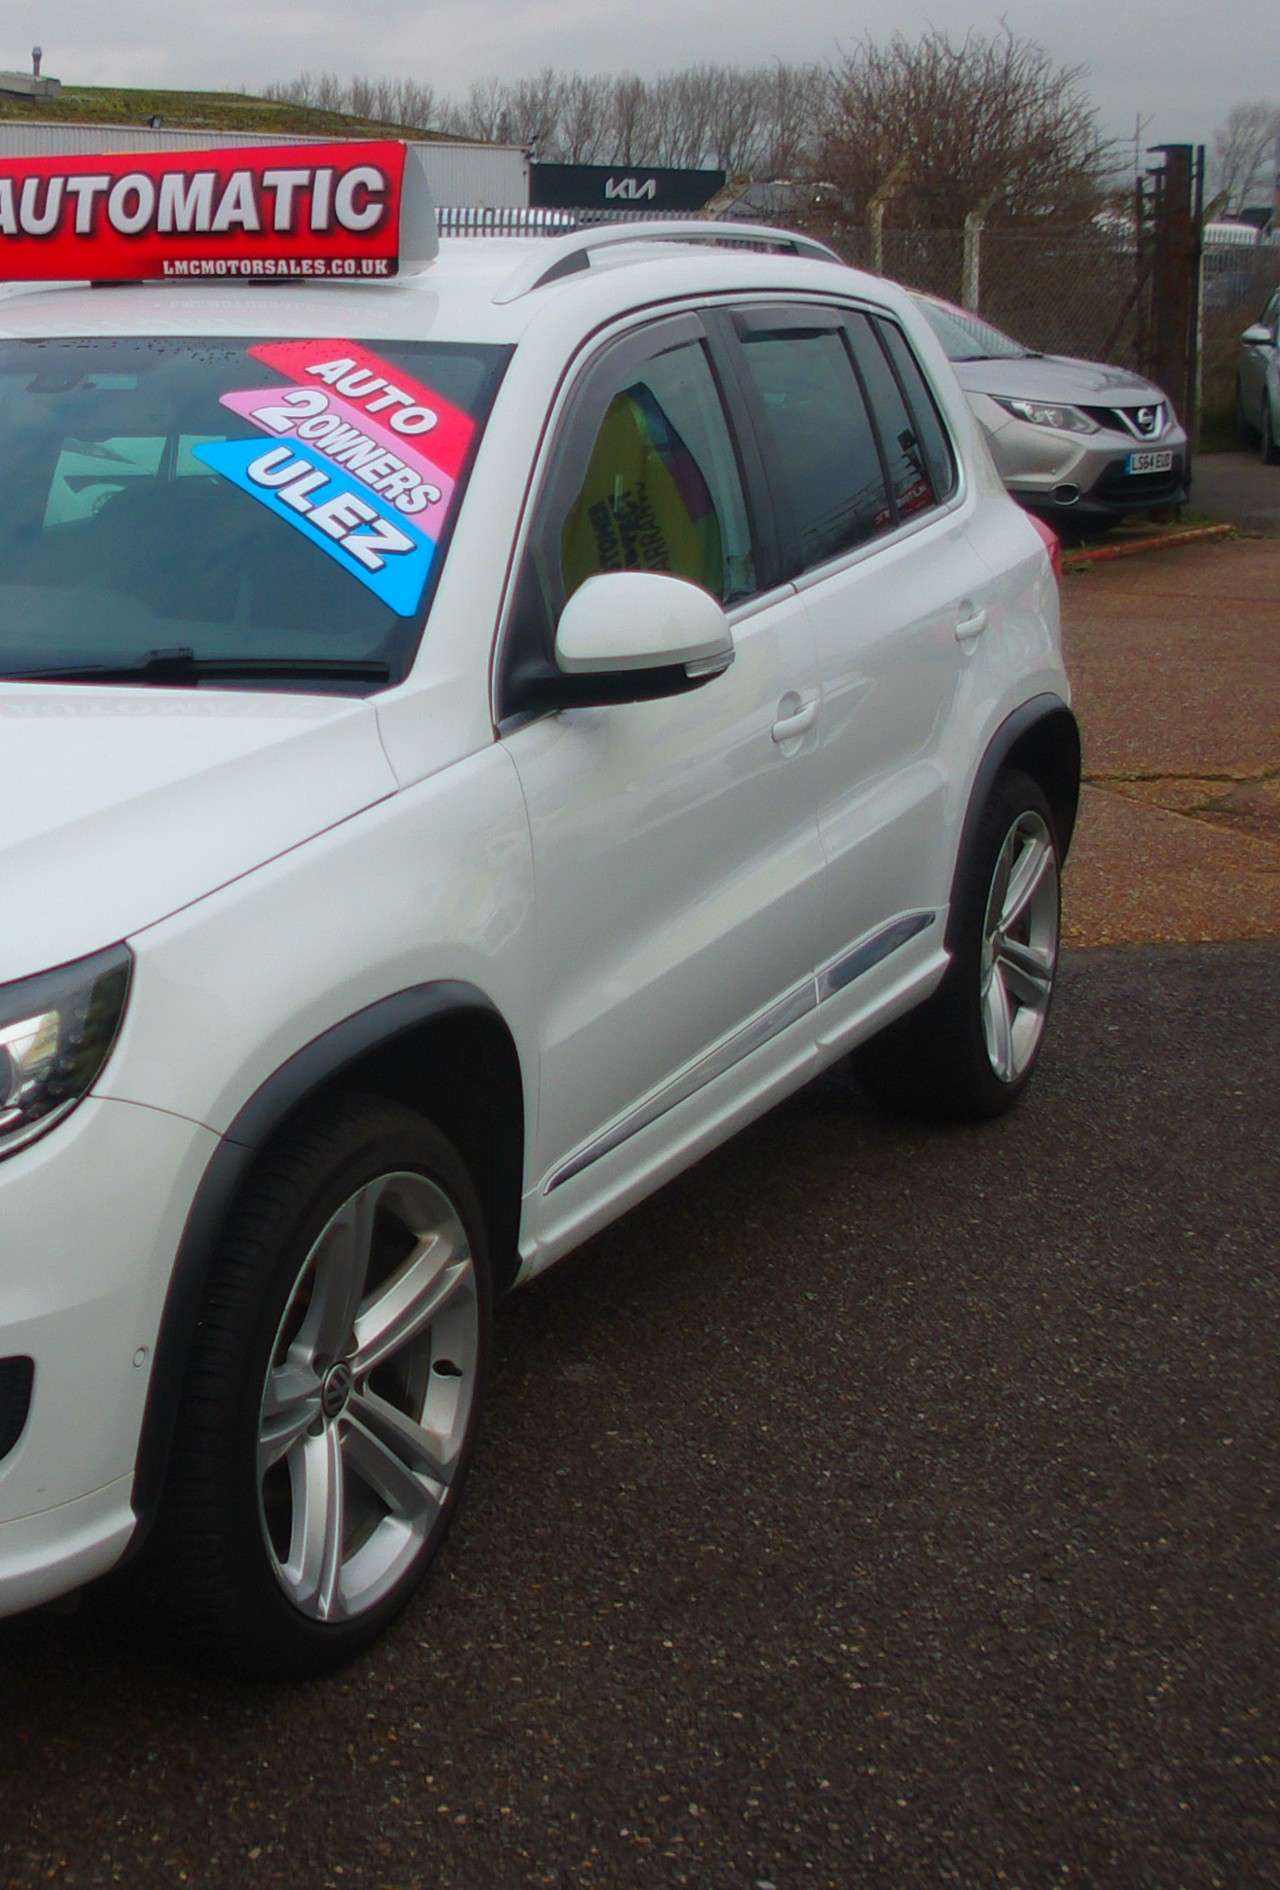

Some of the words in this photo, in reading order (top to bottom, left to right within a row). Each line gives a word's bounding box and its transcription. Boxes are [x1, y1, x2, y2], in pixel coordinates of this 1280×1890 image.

[162, 258, 389, 276] LMCMOTORSALES.CO.UK
[305, 357, 438, 435] AUTO
[246, 446, 417, 573] ULEZ
